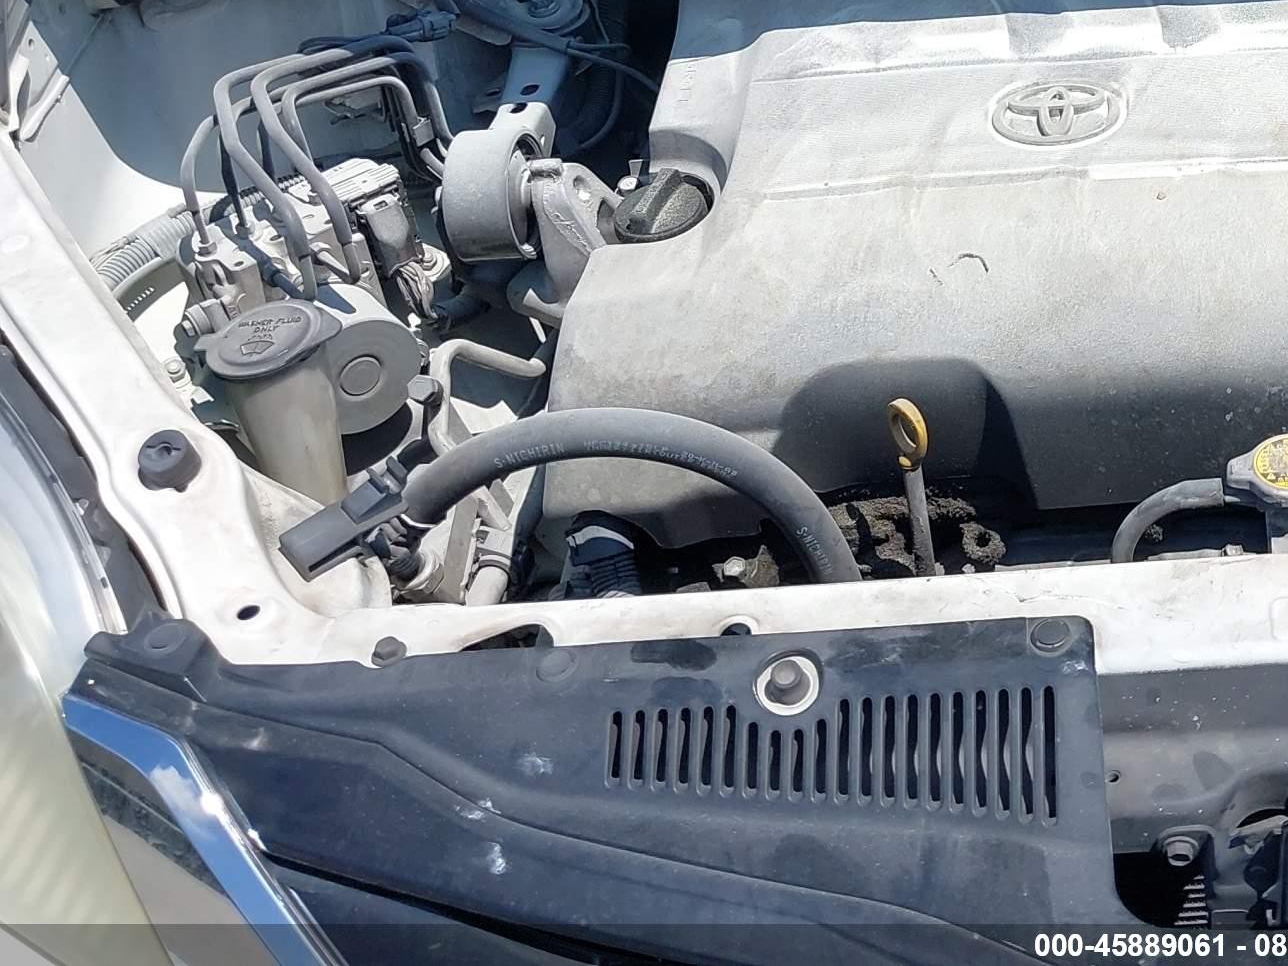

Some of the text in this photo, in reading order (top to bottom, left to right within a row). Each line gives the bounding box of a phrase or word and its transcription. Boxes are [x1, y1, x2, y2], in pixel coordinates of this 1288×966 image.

[238, 315, 302, 328] WASHER FLUID
[253, 324, 280, 334] ONLY
